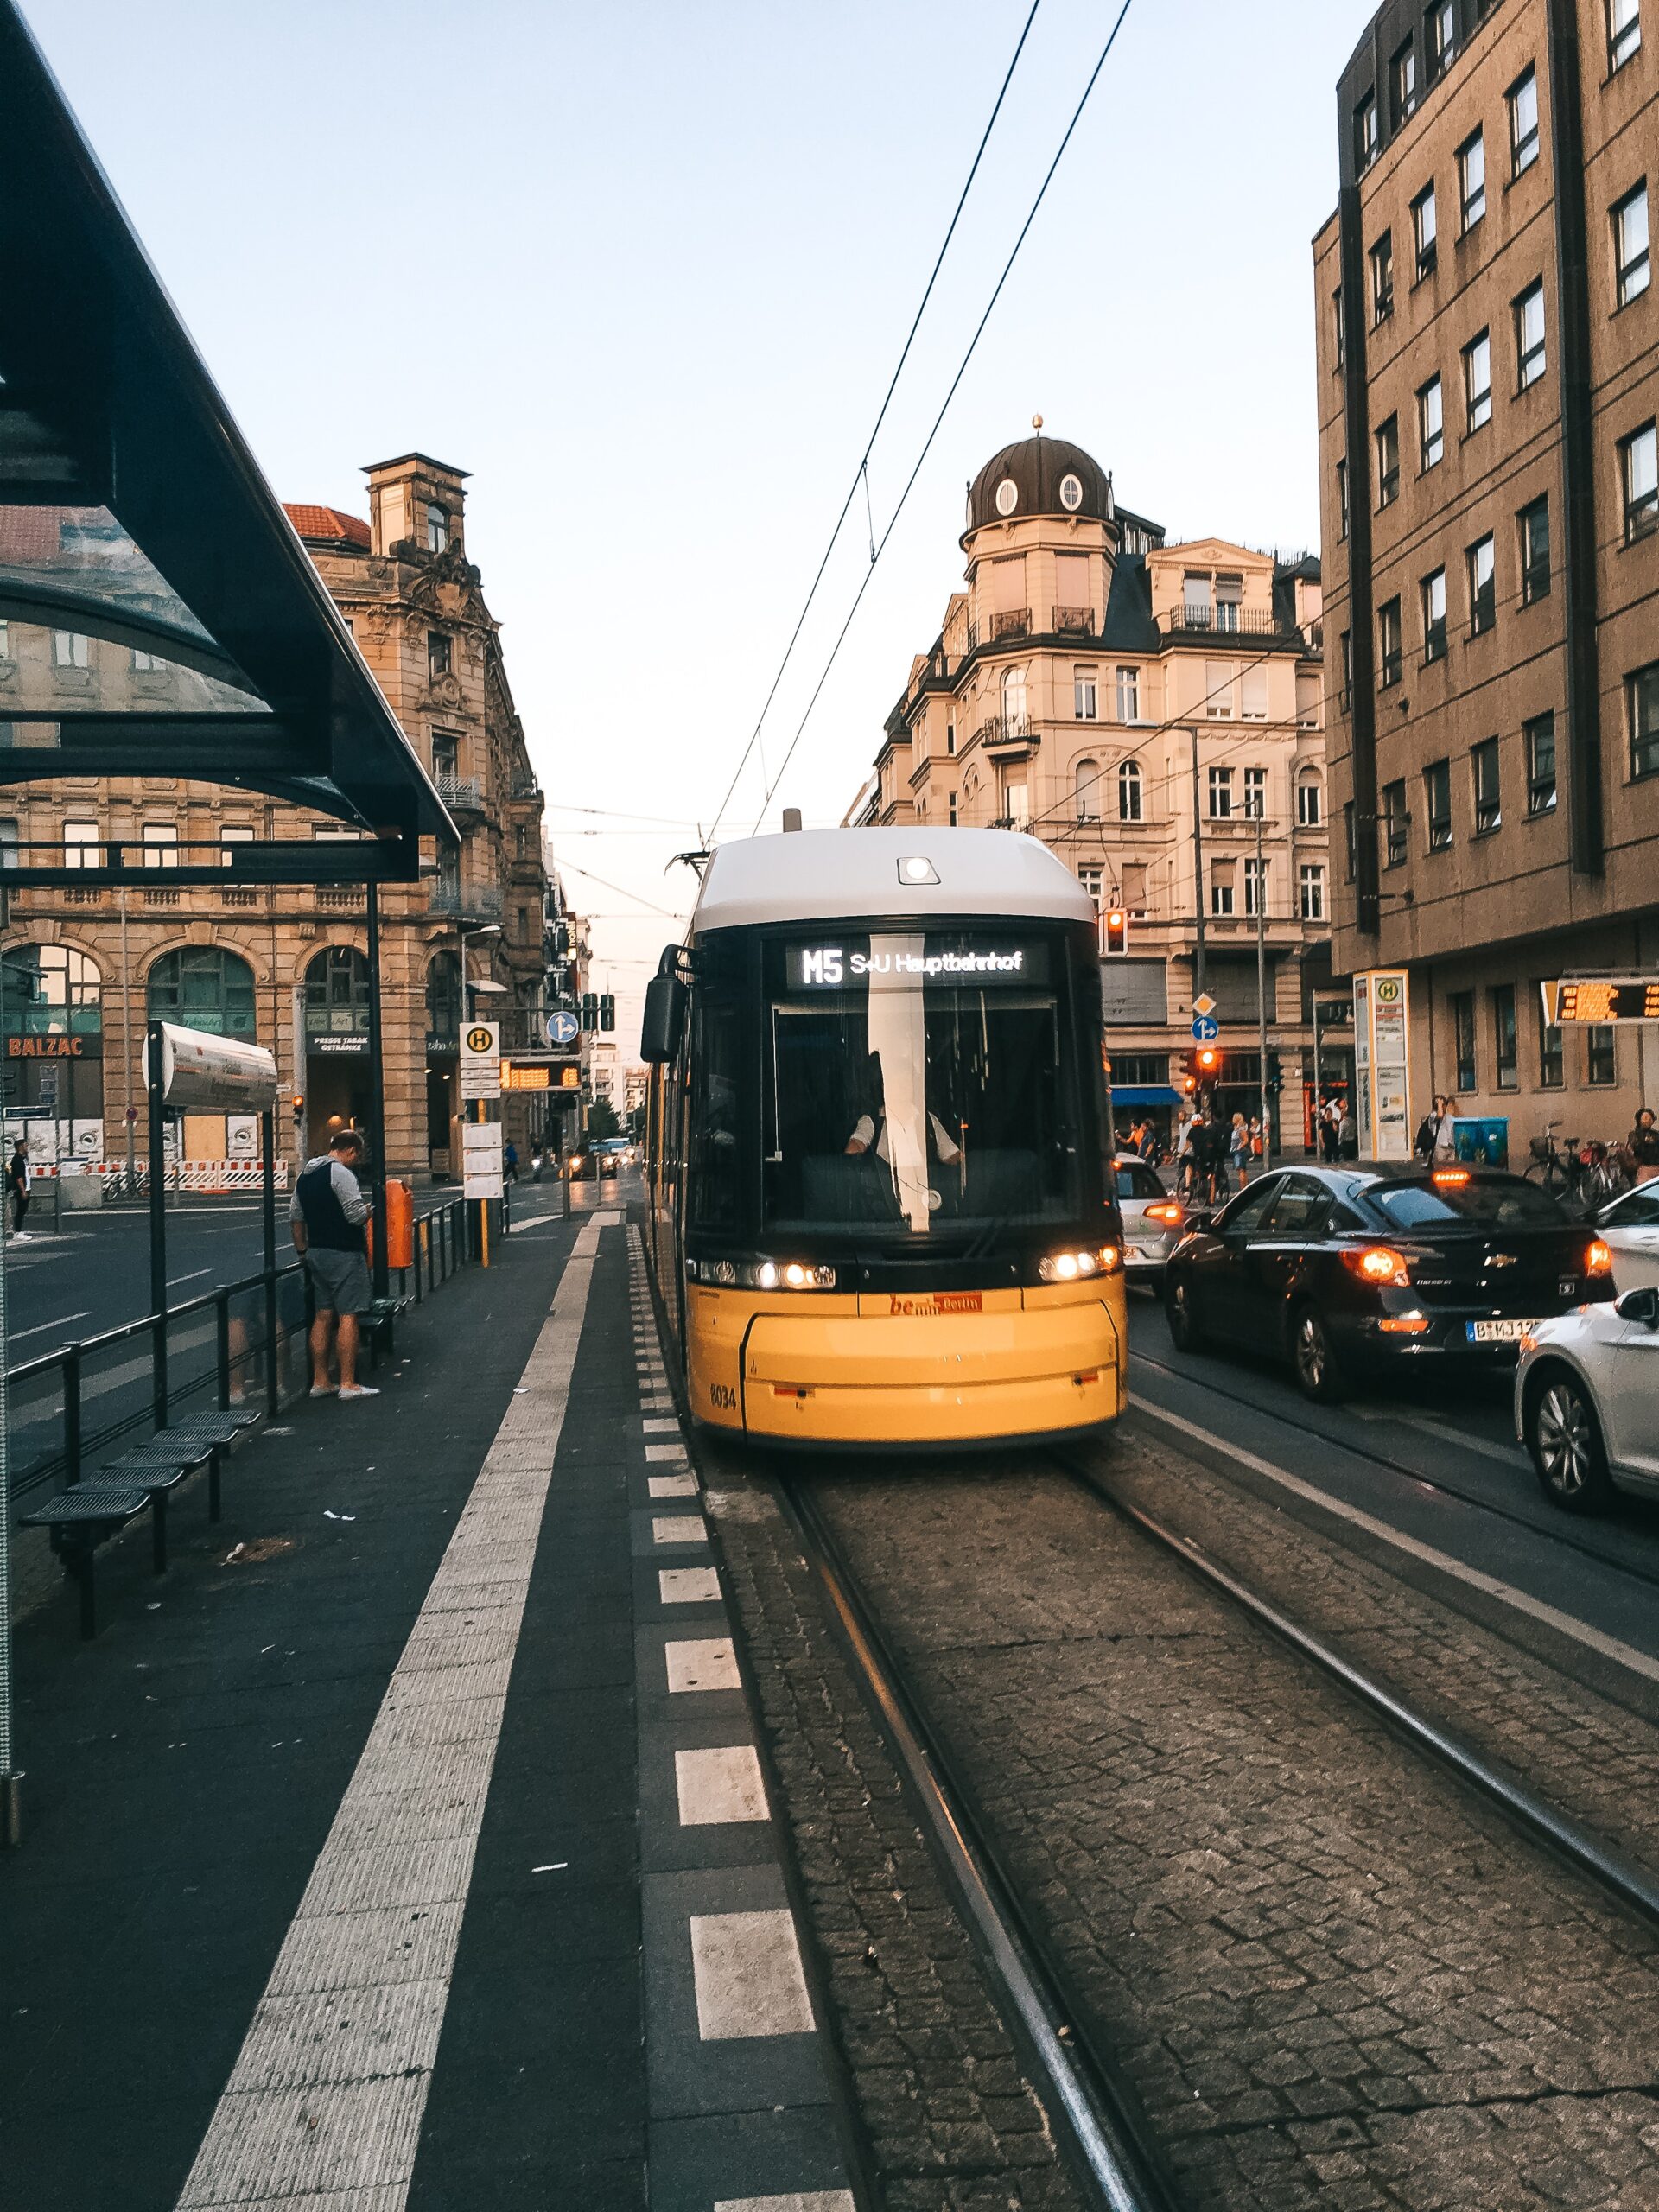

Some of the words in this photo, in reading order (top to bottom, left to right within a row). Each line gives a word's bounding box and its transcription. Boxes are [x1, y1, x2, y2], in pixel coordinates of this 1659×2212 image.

[802, 950, 843, 984] M5
[850, 953, 891, 974] S+U
[895, 950, 1023, 976] Hauptbahnhof
[8, 1037, 84, 1056] BALZAC
[942, 1296, 979, 1312] Berlin
[710, 1382, 737, 1410] 8034
